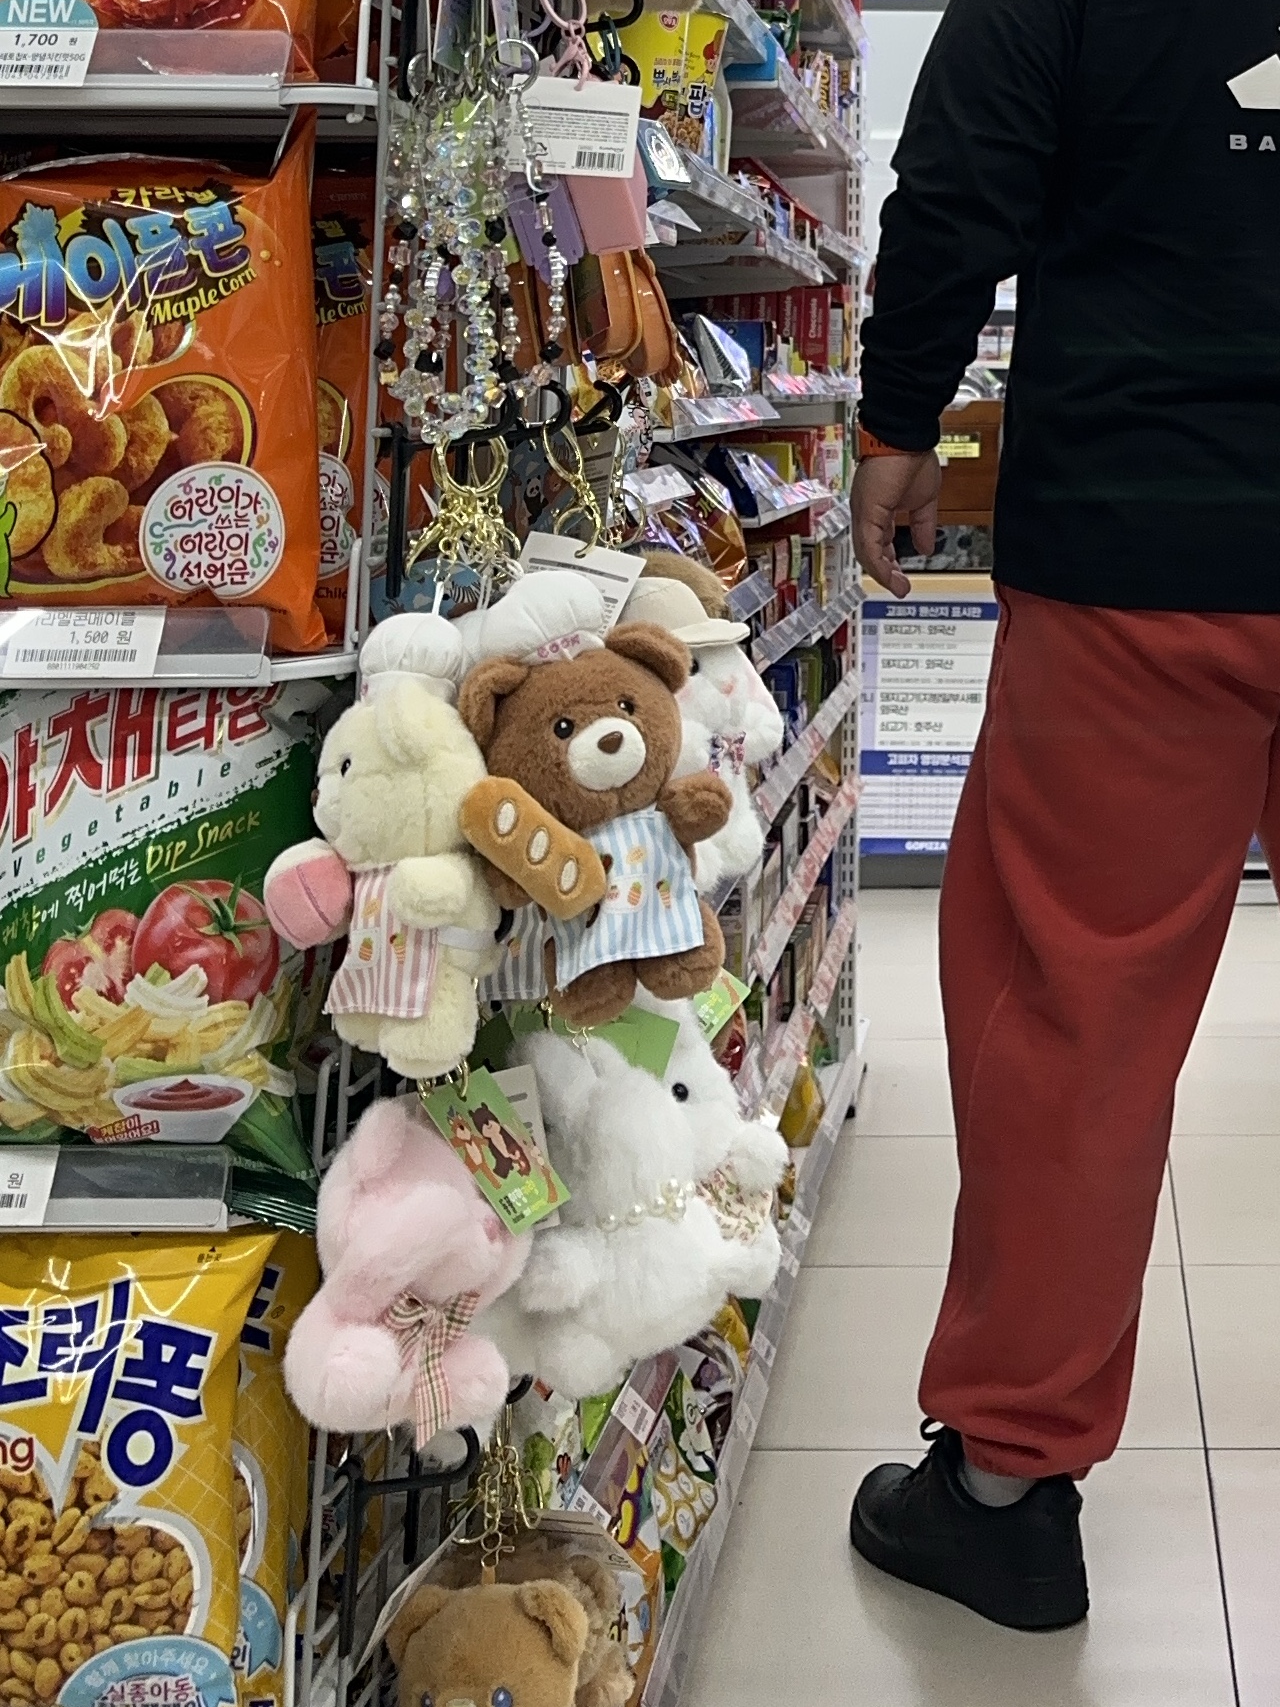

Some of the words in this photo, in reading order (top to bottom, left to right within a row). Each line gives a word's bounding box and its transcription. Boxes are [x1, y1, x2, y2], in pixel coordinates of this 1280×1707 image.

[14, 33, 59, 48] 1,700
[150, 289, 219, 327] Maple
[218, 263, 258, 299] Corn
[69, 630, 110, 645] 1,500
[116, 630, 133, 646] 원
[144, 840, 194, 876] Dip
[195, 806, 261, 852] Snack
[7, 1172, 24, 1191] 원
[105, 1677, 194, 1703] 실종아동
